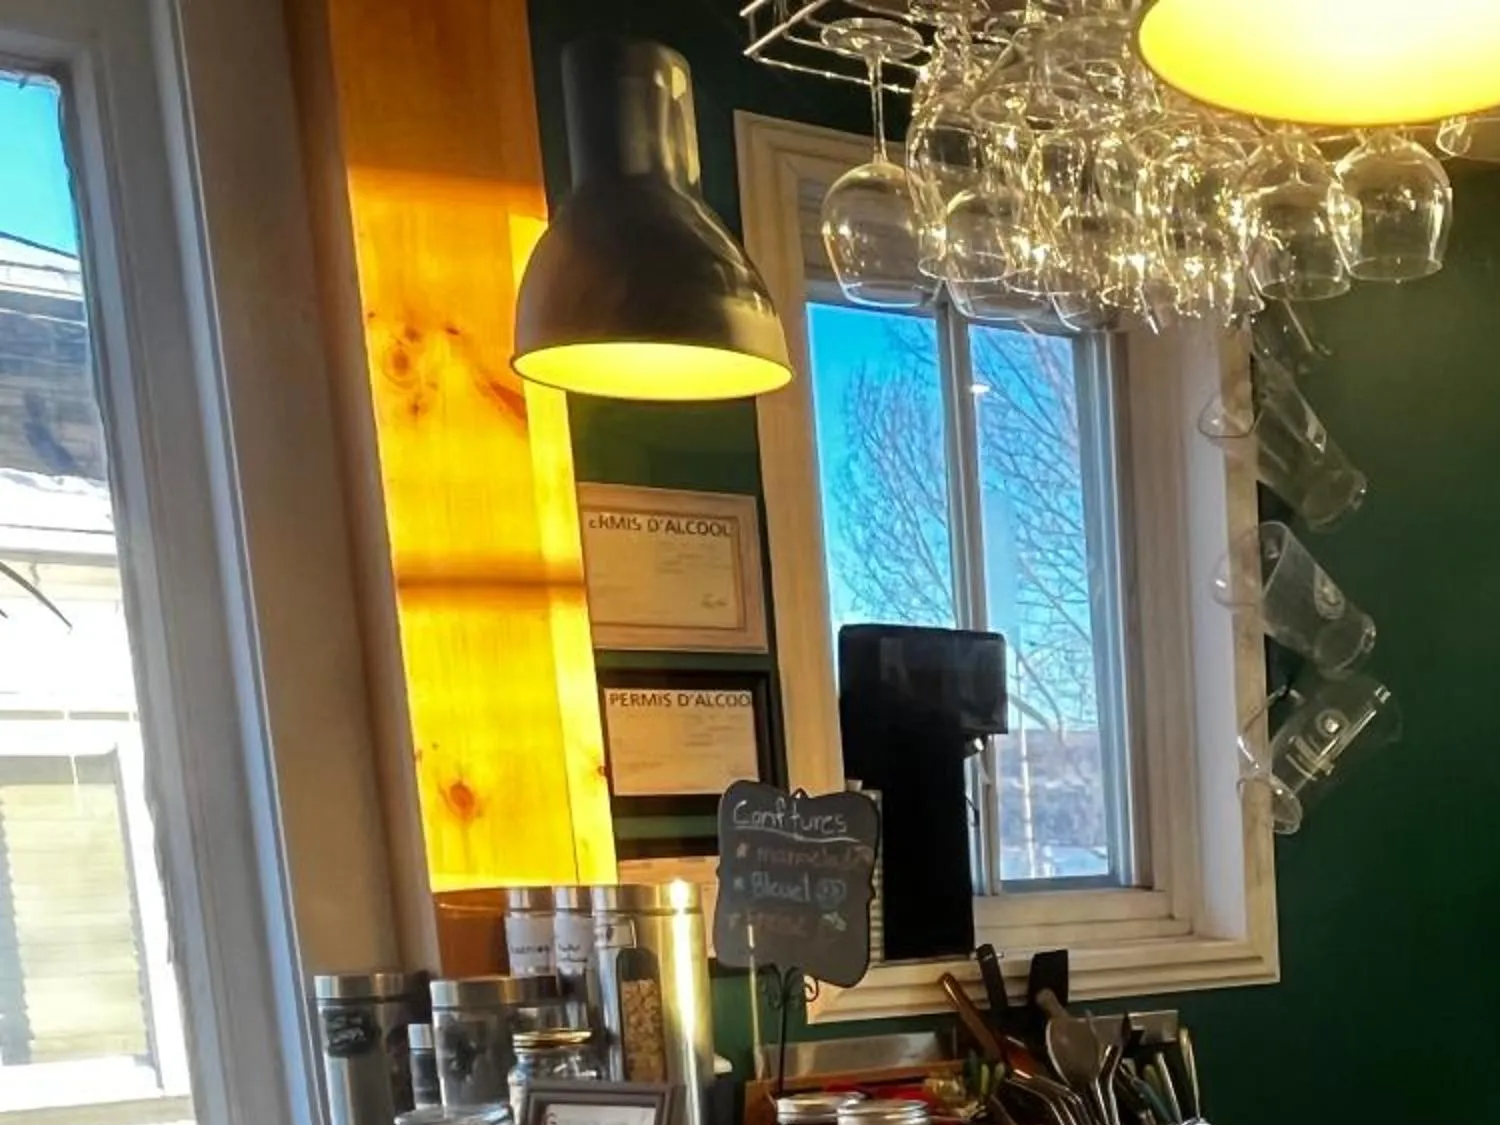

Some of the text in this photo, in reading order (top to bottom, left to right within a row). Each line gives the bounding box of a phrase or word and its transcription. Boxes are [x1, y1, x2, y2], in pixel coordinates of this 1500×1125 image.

[609, 692, 752, 708] PERMIS D'ALCOO
[732, 797, 848, 835] Conftures
